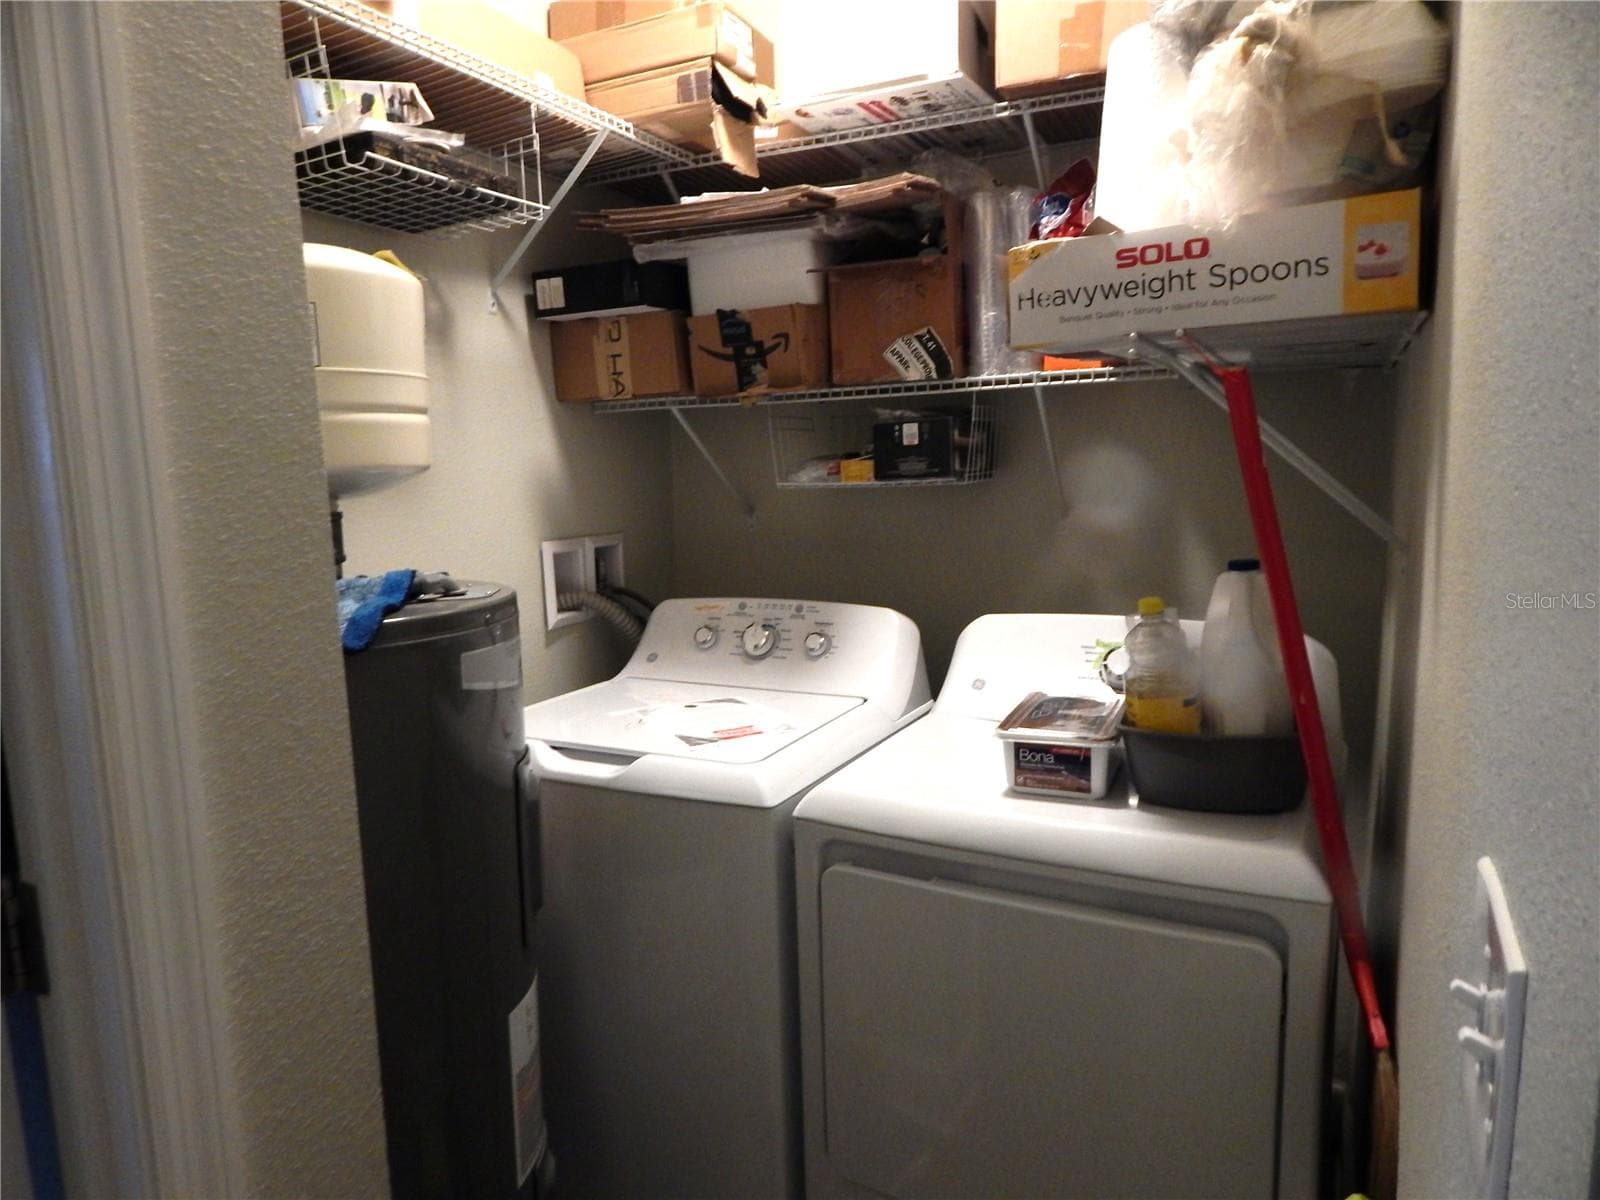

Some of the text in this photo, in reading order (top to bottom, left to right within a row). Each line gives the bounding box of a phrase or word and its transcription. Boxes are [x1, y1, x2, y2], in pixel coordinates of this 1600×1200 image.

[1115, 237, 1210, 269] SOLO
[1017, 255, 1330, 311] Heavyweight Spoons
[1019, 748, 1055, 764] Bona
